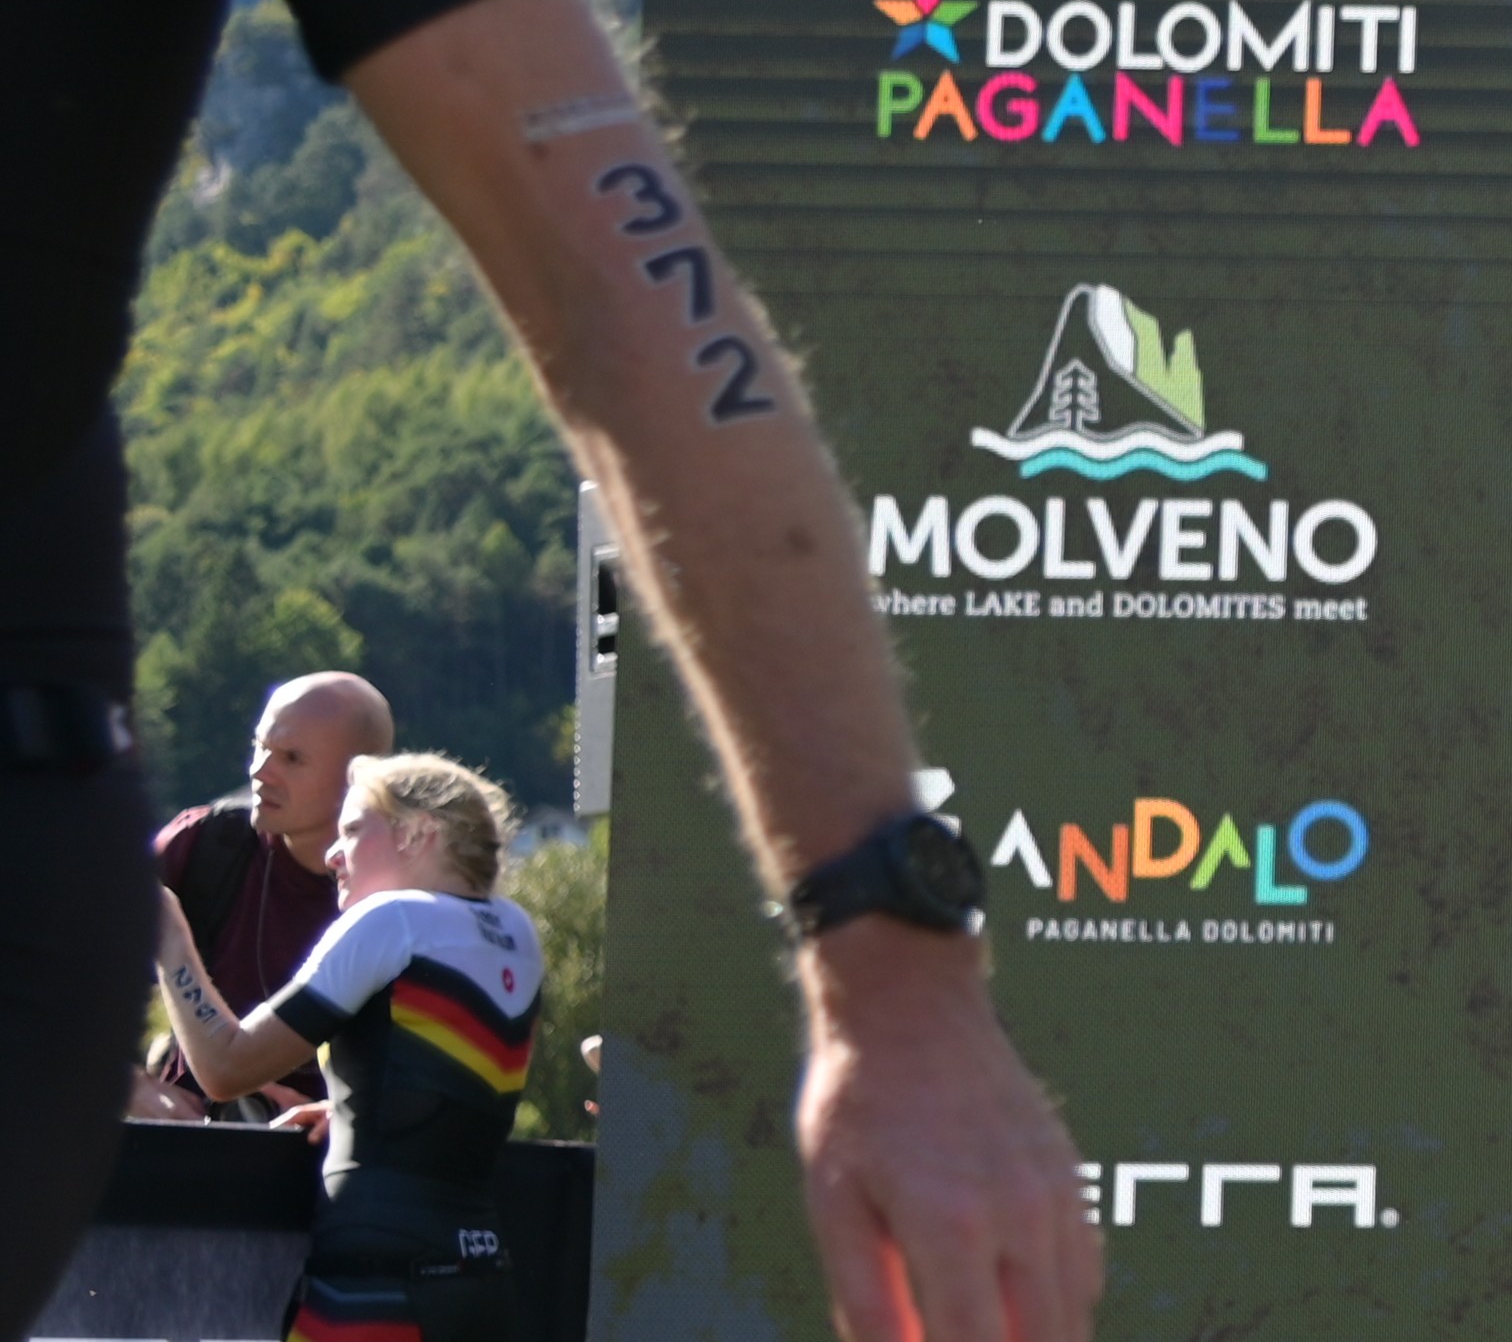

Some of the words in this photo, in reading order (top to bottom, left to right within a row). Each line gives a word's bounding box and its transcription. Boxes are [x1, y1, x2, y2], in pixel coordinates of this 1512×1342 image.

[986, 0, 1417, 73] DOLOMITI
[876, 71, 1420, 147] PAGANELLA
[594, 162, 775, 424] 372
[868, 495, 1376, 583] MOLVENO
[965, 591, 1041, 617] LAKE
[1048, 592, 1104, 618] and
[1112, 593, 1286, 620] DOLOMITES
[1293, 597, 1369, 622] meet
[992, 798, 1368, 904] ANDALO
[1026, 918, 1191, 942] PAGANELLA
[1201, 919, 1335, 944] DOLOMITI
